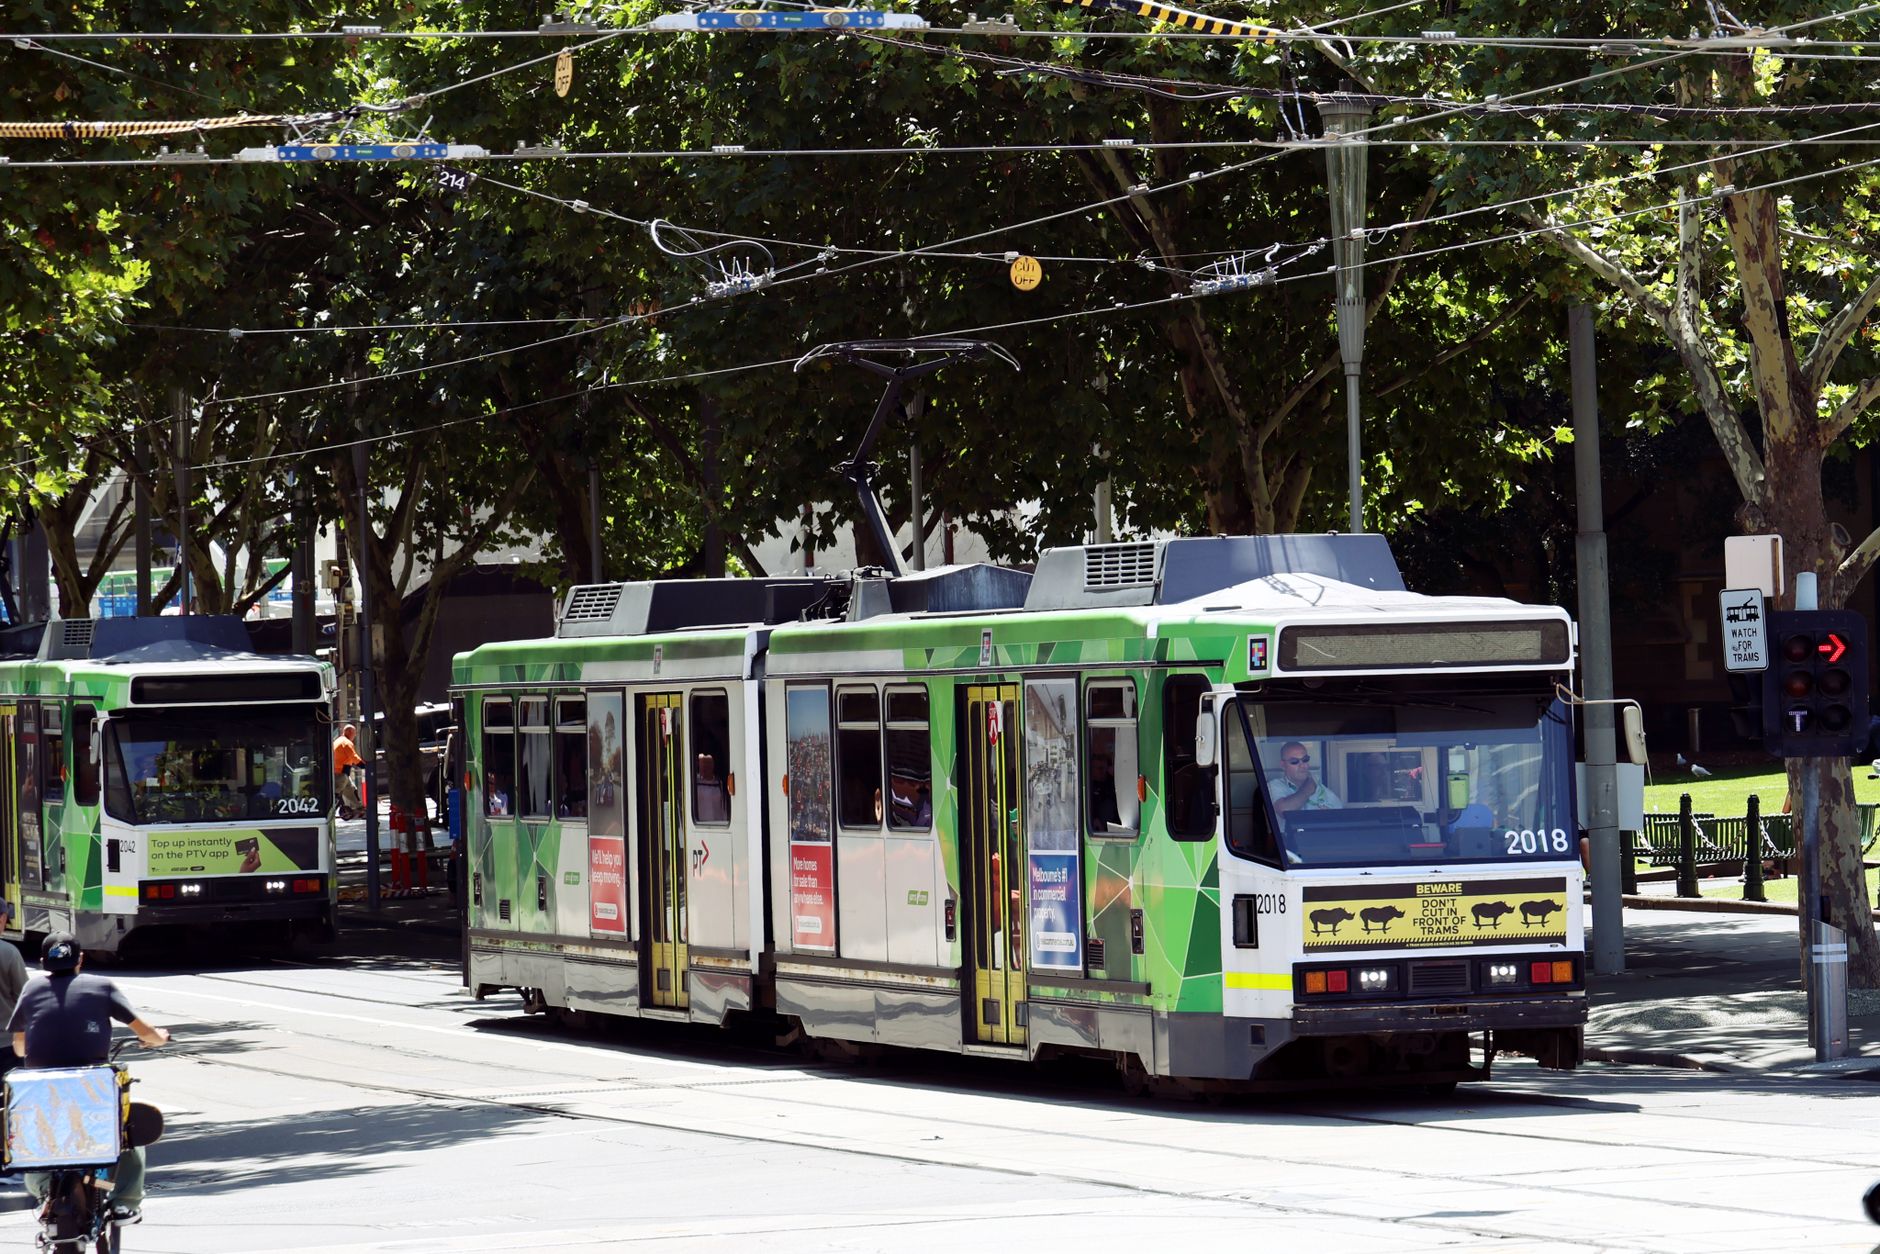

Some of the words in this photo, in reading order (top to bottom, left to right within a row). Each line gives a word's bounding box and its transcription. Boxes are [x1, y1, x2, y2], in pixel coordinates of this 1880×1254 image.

[557, 54, 571, 71] CUT
[557, 75, 570, 91] OFF
[438, 171, 465, 190] 214
[1014, 260, 1036, 272] CUT
[1014, 274, 1036, 286] OFF
[1731, 628, 1757, 638] WATCH
[1738, 641, 1753, 651] FOR
[1733, 652, 1760, 663] TRAMS
[277, 797, 320, 814] 2042
[119, 839, 136, 853] 2042
[151, 839, 170, 849] Top
[172, 840, 185, 849] up
[187, 837, 232, 848] instantly
[1504, 828, 1569, 855] 2018
[167, 850, 183, 859] the
[186, 849, 208, 858] PTV
[208, 850, 229, 859] app
[602, 851, 613, 868] help
[613, 854, 622, 868] you
[793, 857, 803, 871] More
[803, 858, 818, 871] homes
[592, 868, 603, 886] keep
[808, 874, 818, 888] than
[1032, 867, 1061, 882] Melbourne's
[1038, 886, 1066, 901] commercial
[1416, 883, 1463, 894] BEWARE
[1257, 893, 1287, 915] 2018
[1421, 898, 1456, 908] DON'T
[1421, 908, 1445, 917] CUT
[1446, 907, 1458, 916] IN
[1412, 917, 1449, 926] FRONT
[1452, 916, 1467, 925] OF
[1420, 925, 1459, 936] TRAMS
